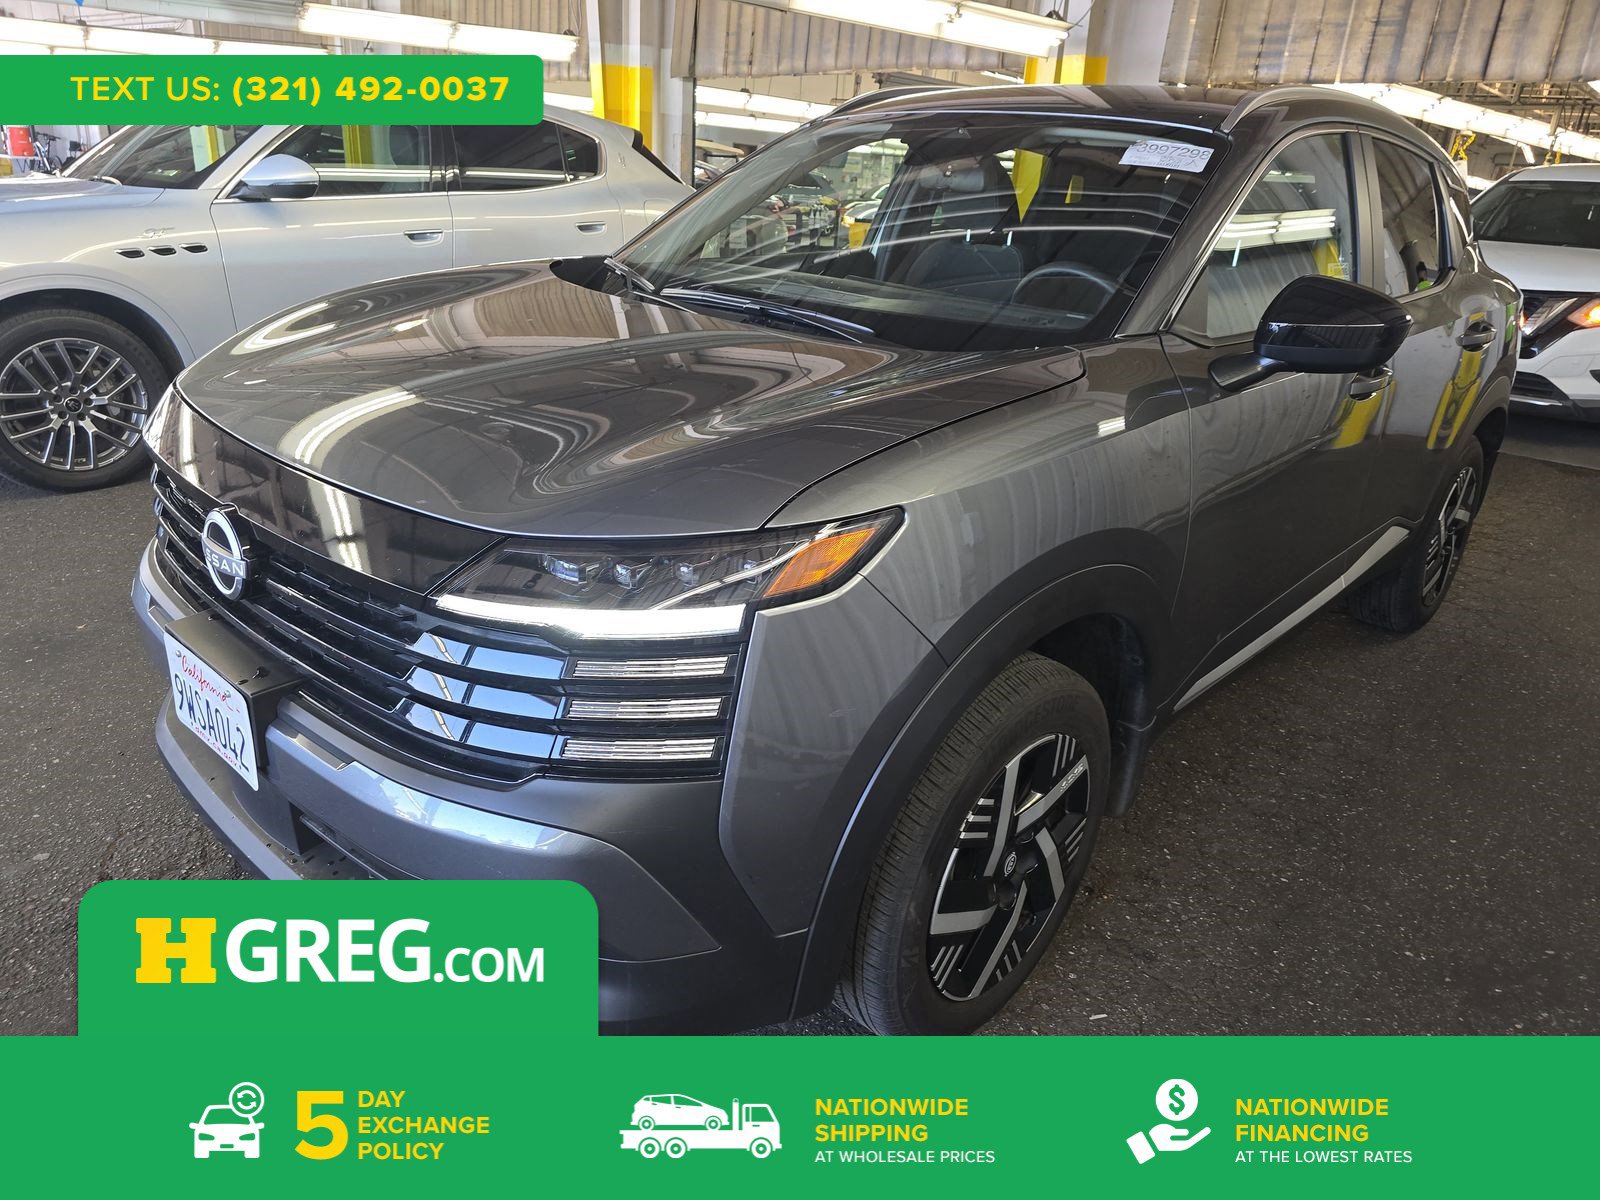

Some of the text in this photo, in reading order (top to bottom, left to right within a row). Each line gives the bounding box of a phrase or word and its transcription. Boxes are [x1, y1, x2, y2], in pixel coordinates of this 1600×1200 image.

[204, 547, 245, 577] SSAN
[181, 655, 233, 710] California
[174, 673, 249, 772] 9WSA042
